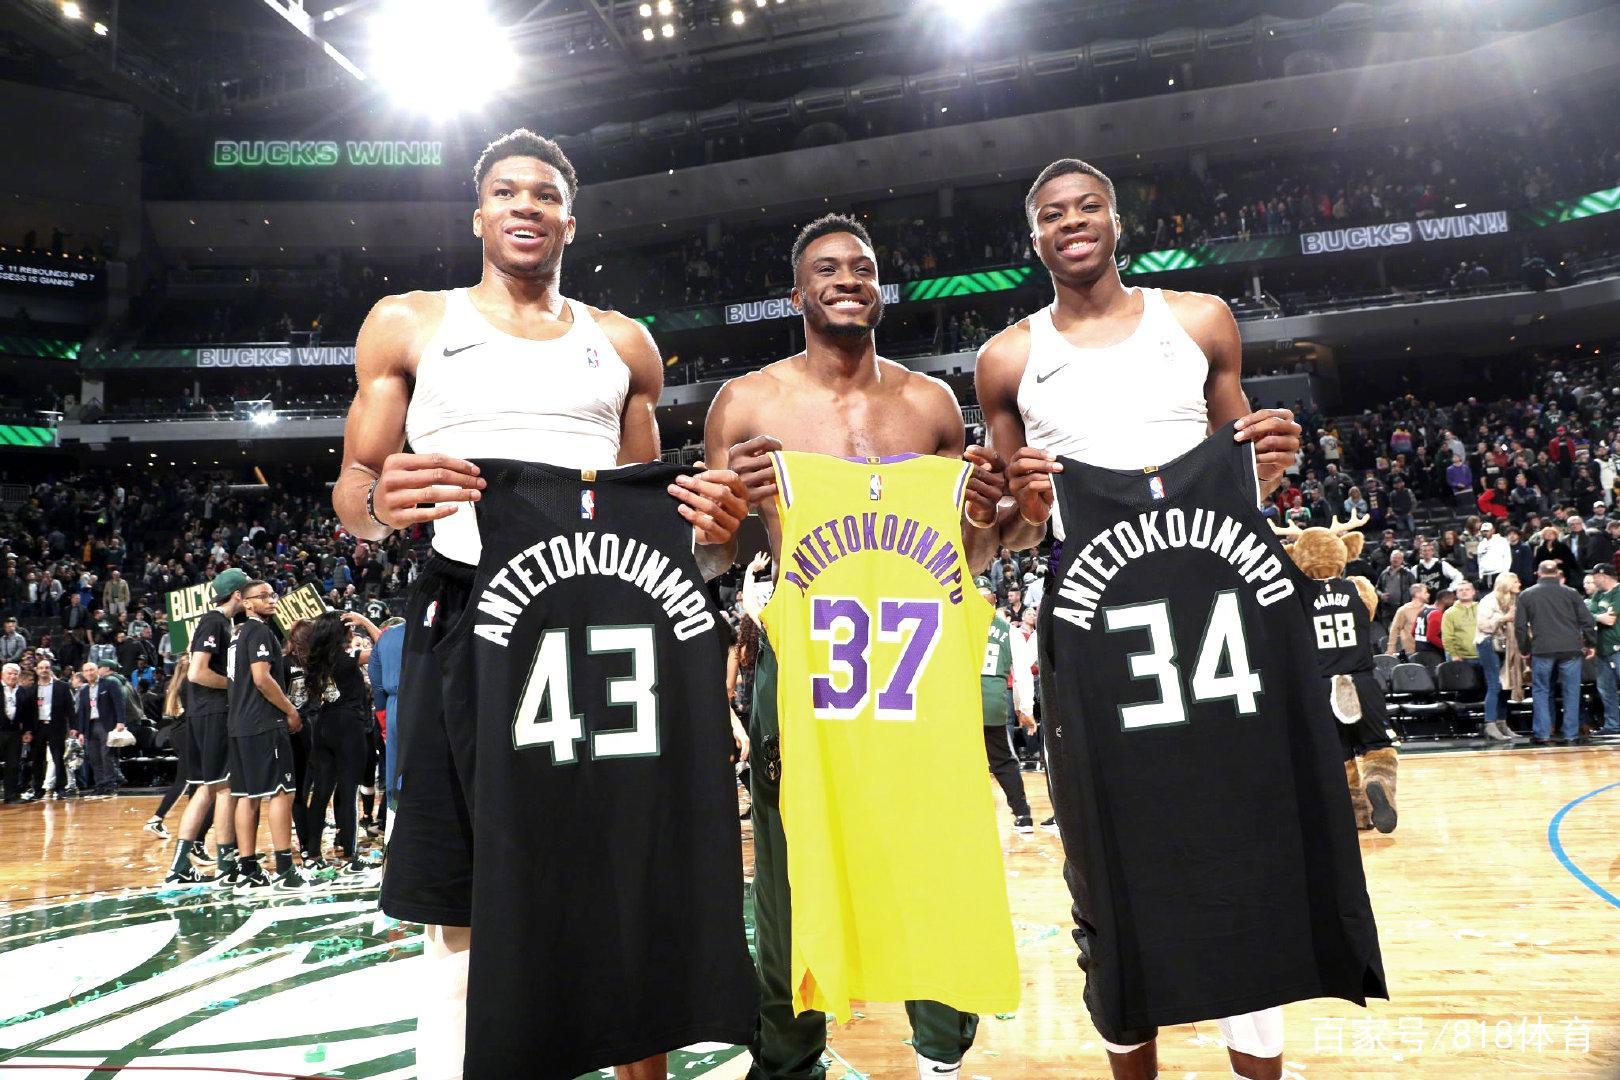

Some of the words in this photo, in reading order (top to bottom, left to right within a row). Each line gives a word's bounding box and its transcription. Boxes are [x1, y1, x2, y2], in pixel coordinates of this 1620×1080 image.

[213, 141, 339, 165] BUCKS
[346, 141, 442, 165] WIN!!
[1301, 222, 1412, 254] BUCKS
[1416, 211, 1509, 241] WIN!!
[20, 266, 69, 278] REBOUNDS
[70, 272, 88, 281] AND
[725, 298, 803, 324] BUCK
[196, 347, 292, 368] BUCKS
[297, 346, 356, 366] WIN
[473, 531, 716, 647] ANTETOKOUNMPO
[1053, 507, 1295, 631] ANTETOKOUNMPO
[1313, 612, 1357, 649] 68
[810, 595, 942, 720] 37
[1102, 588, 1265, 732] 34
[511, 624, 660, 766] 43
